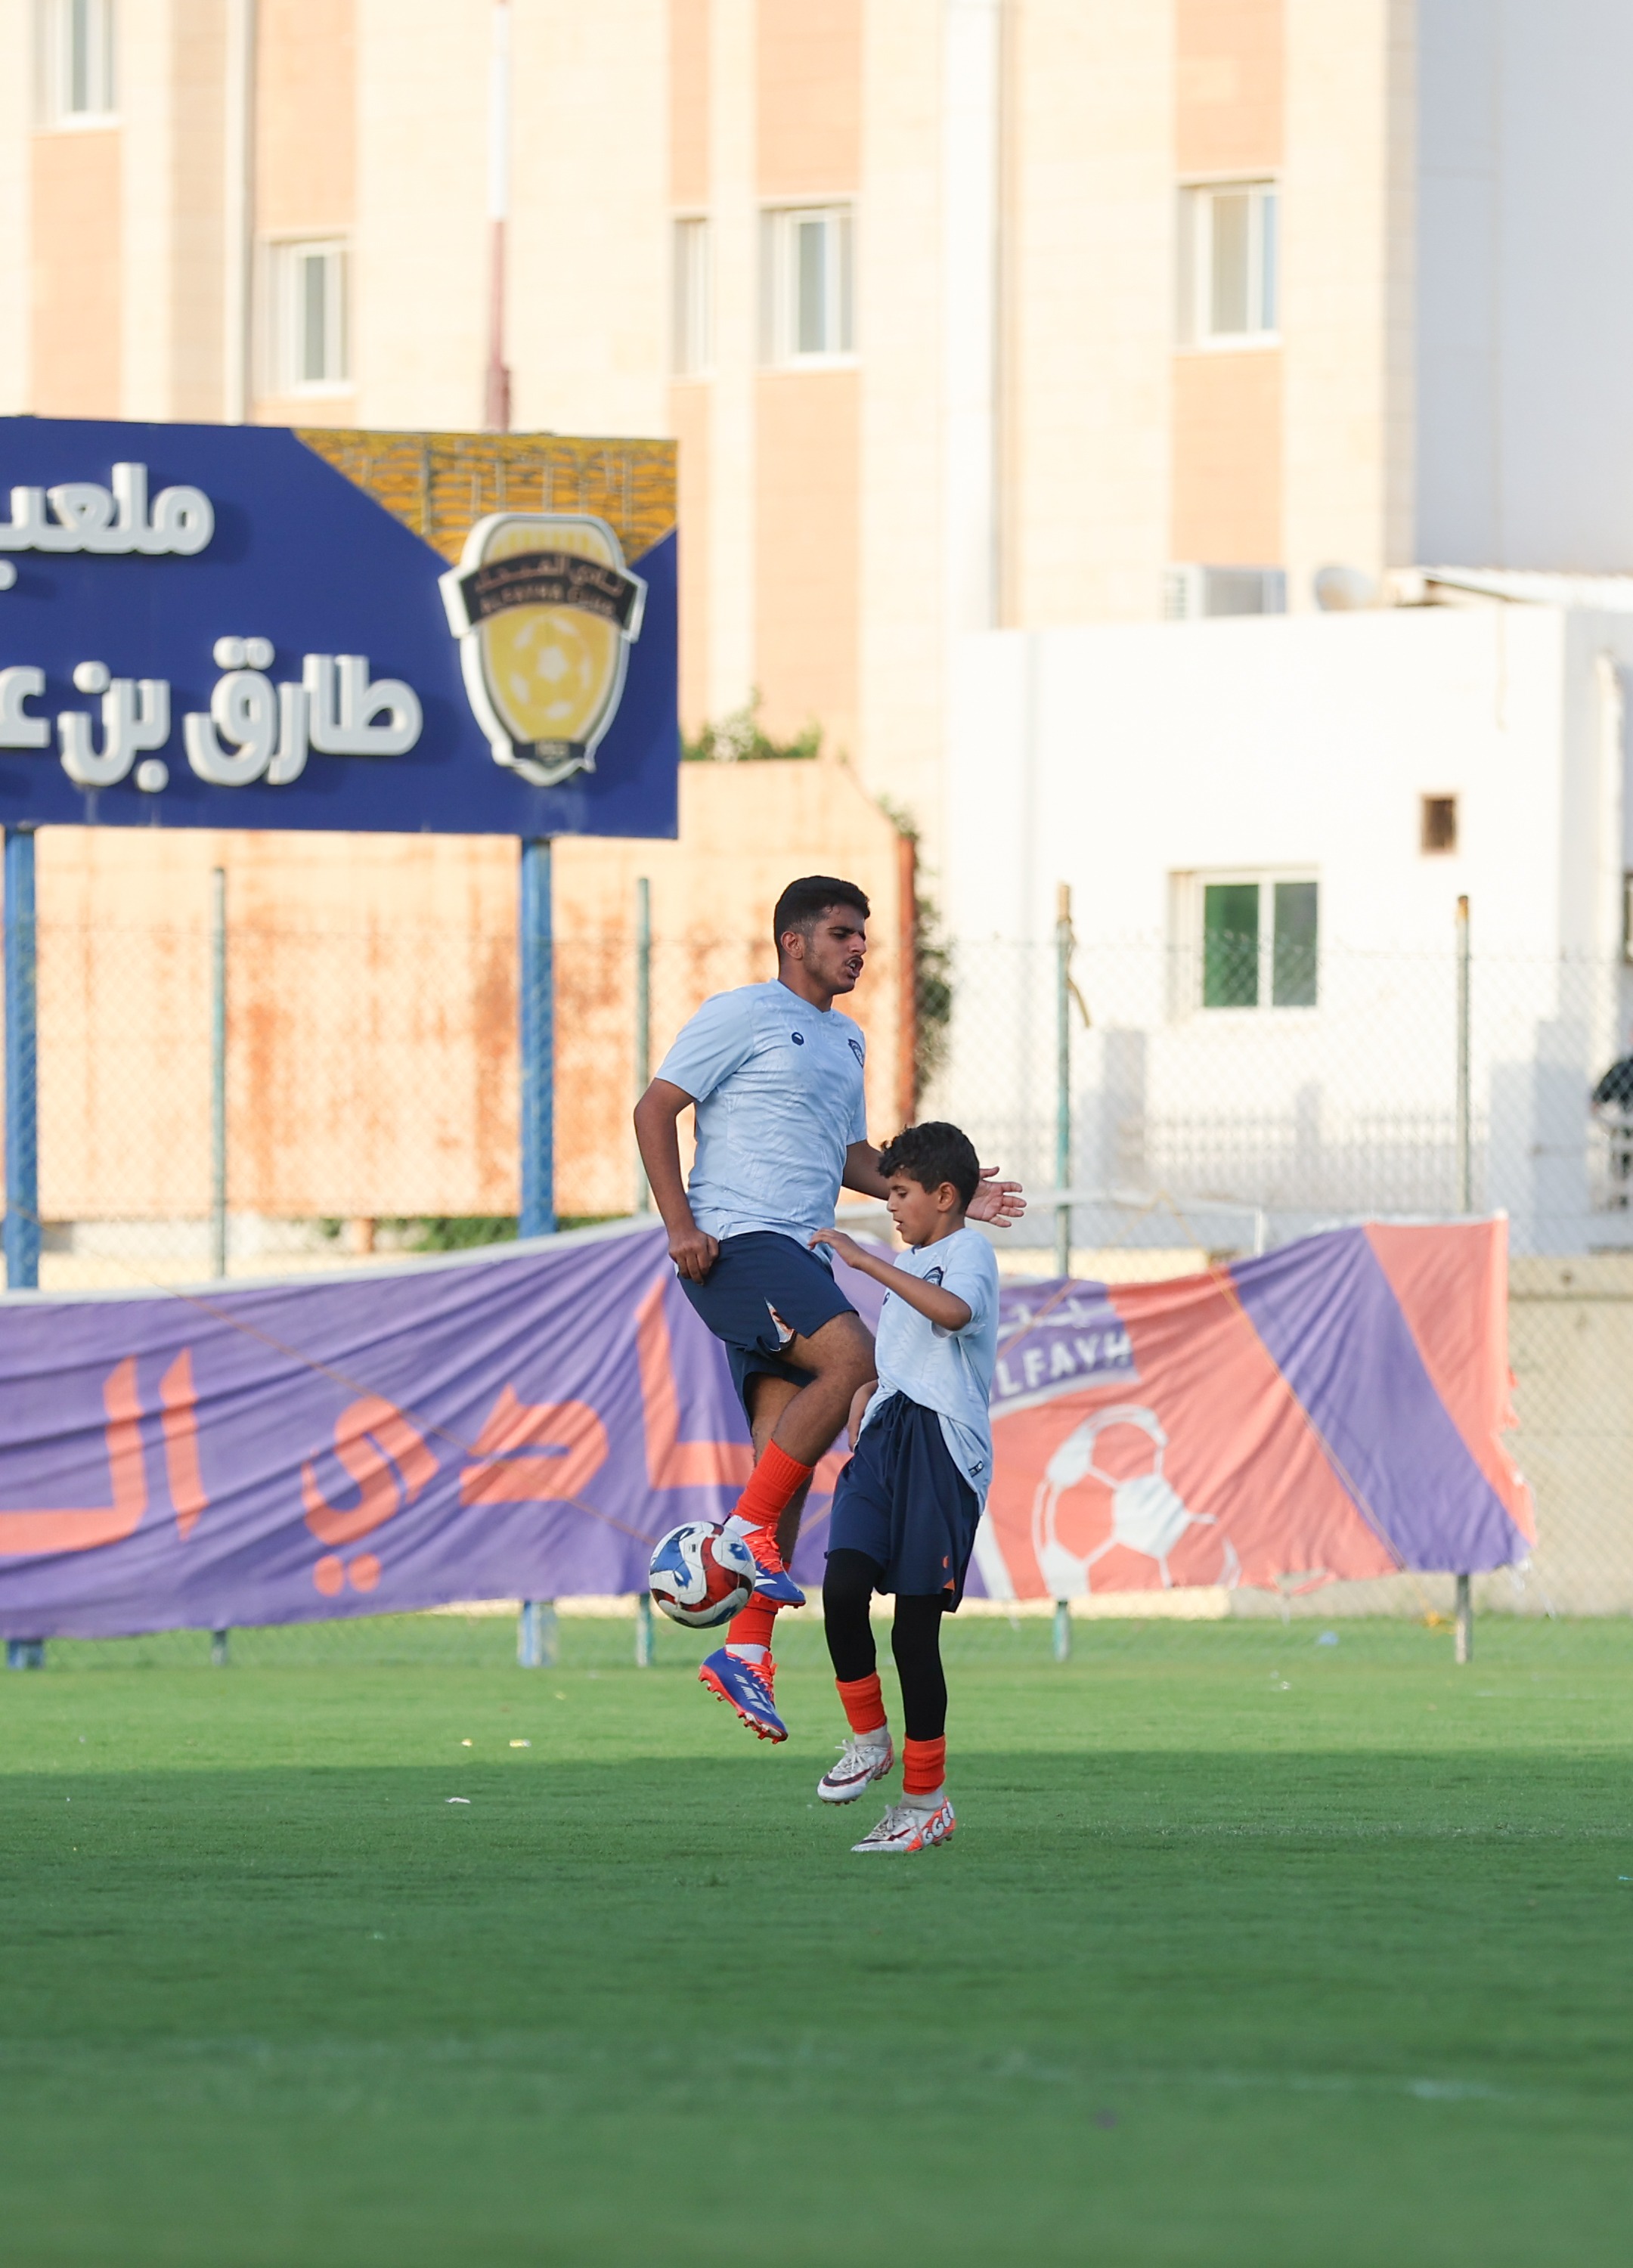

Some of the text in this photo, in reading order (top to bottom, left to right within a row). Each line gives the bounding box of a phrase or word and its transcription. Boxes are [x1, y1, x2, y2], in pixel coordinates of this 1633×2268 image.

[57, 661, 171, 793] بن
[184, 636, 423, 786] طارق
[990, 1330, 1129, 1397] LFAYH
